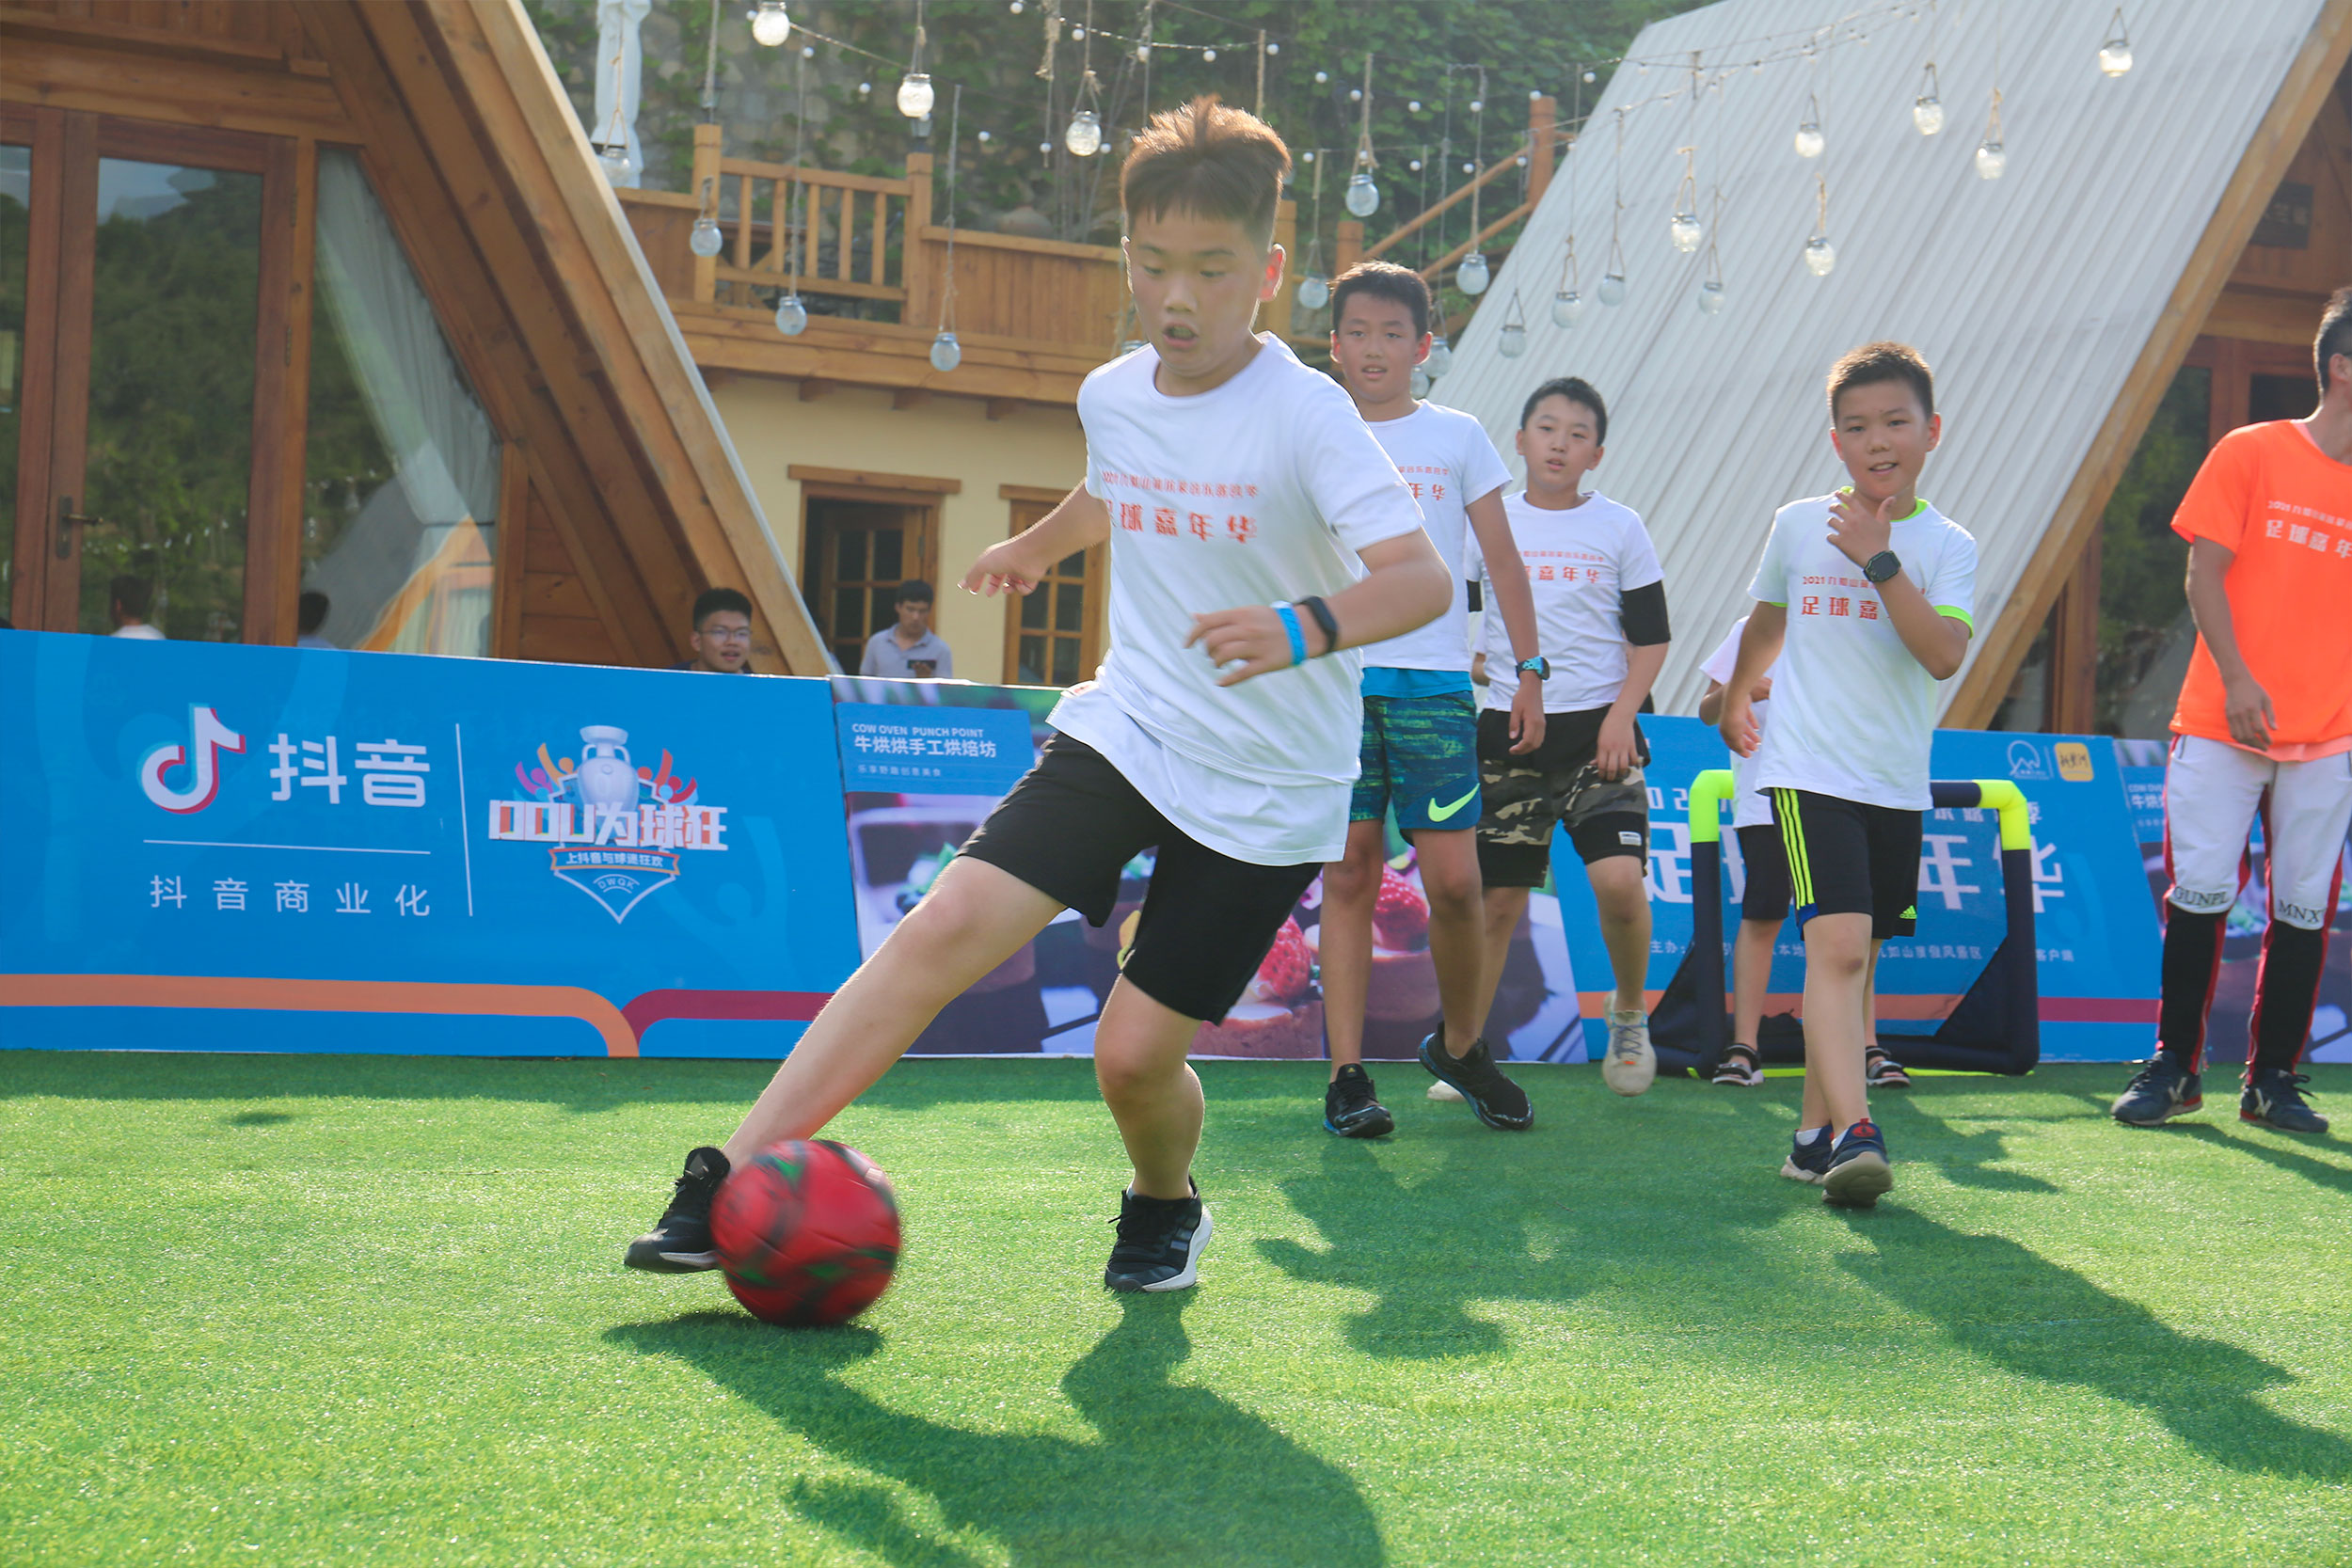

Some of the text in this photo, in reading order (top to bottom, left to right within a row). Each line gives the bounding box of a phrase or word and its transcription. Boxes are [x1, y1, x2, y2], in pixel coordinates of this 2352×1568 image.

[852, 723, 984, 738] COW OVEN PUNCH POINT
[854, 736, 997, 758] 牛烘烘手工烘焙坊
[268, 733, 431, 807] 抖音
[151, 874, 431, 917] 抖音商业化
